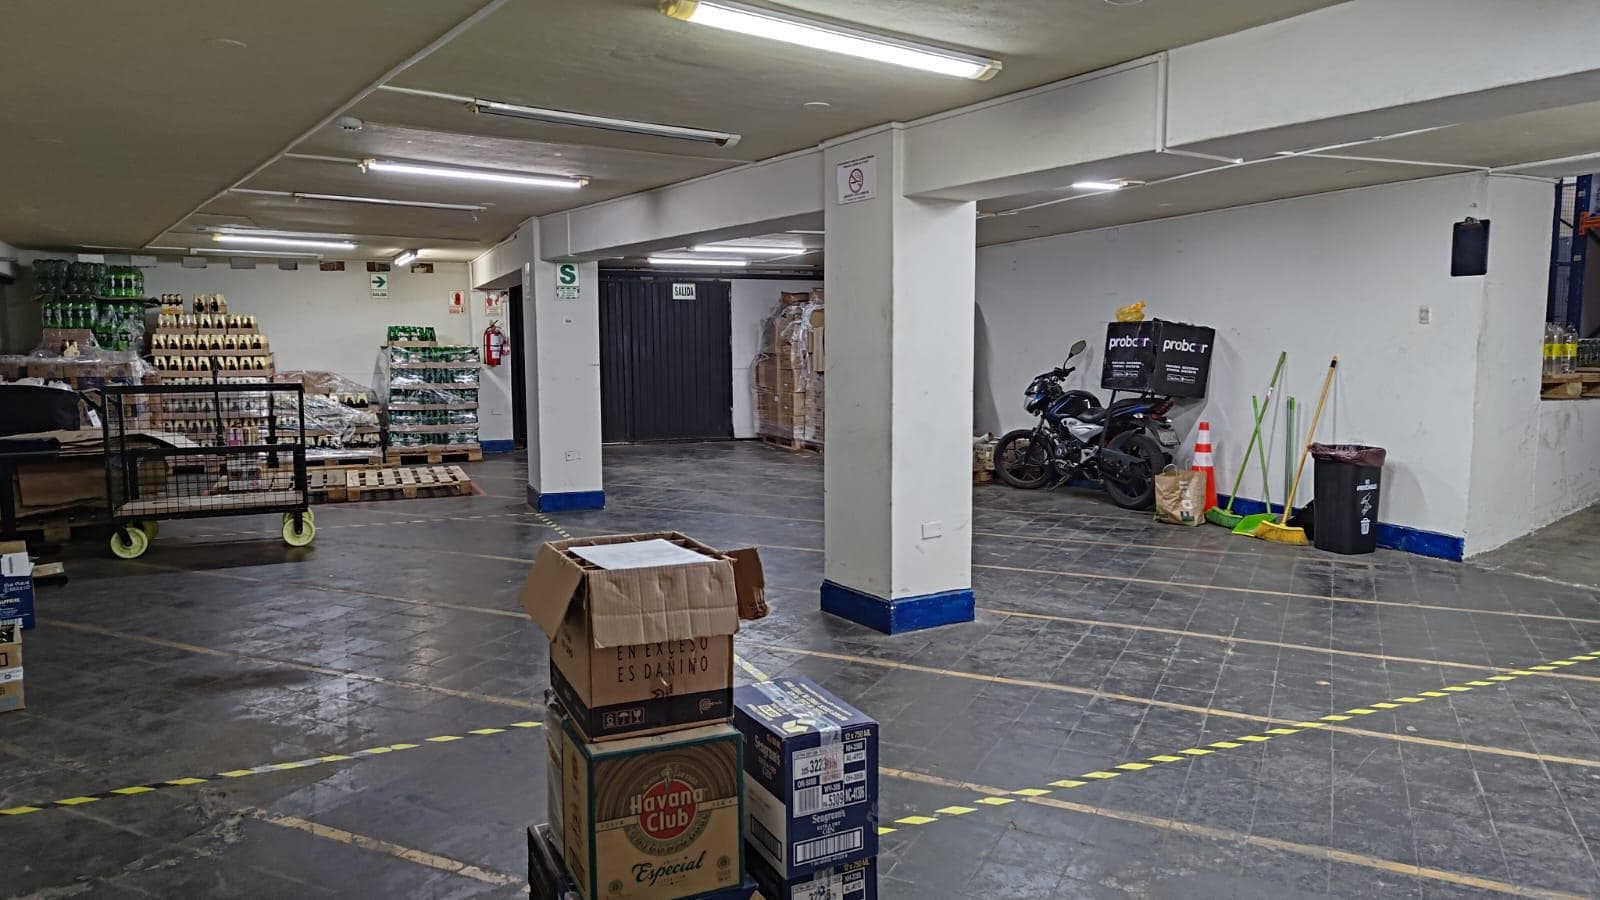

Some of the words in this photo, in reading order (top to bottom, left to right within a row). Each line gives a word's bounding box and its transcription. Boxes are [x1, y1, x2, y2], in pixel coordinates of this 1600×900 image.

[560, 264, 576, 284] S
[674, 286, 695, 297] SALIDA
[1109, 335, 1150, 351] probcr
[1162, 338, 1209, 354] probcr
[617, 645, 636, 661] EN
[645, 637, 708, 658] EXCESO
[617, 664, 636, 683] ES
[644, 656, 709, 680] DAÑINO
[630, 788, 705, 815] Havana
[646, 808, 689, 832] Club
[631, 850, 707, 887] Especial
